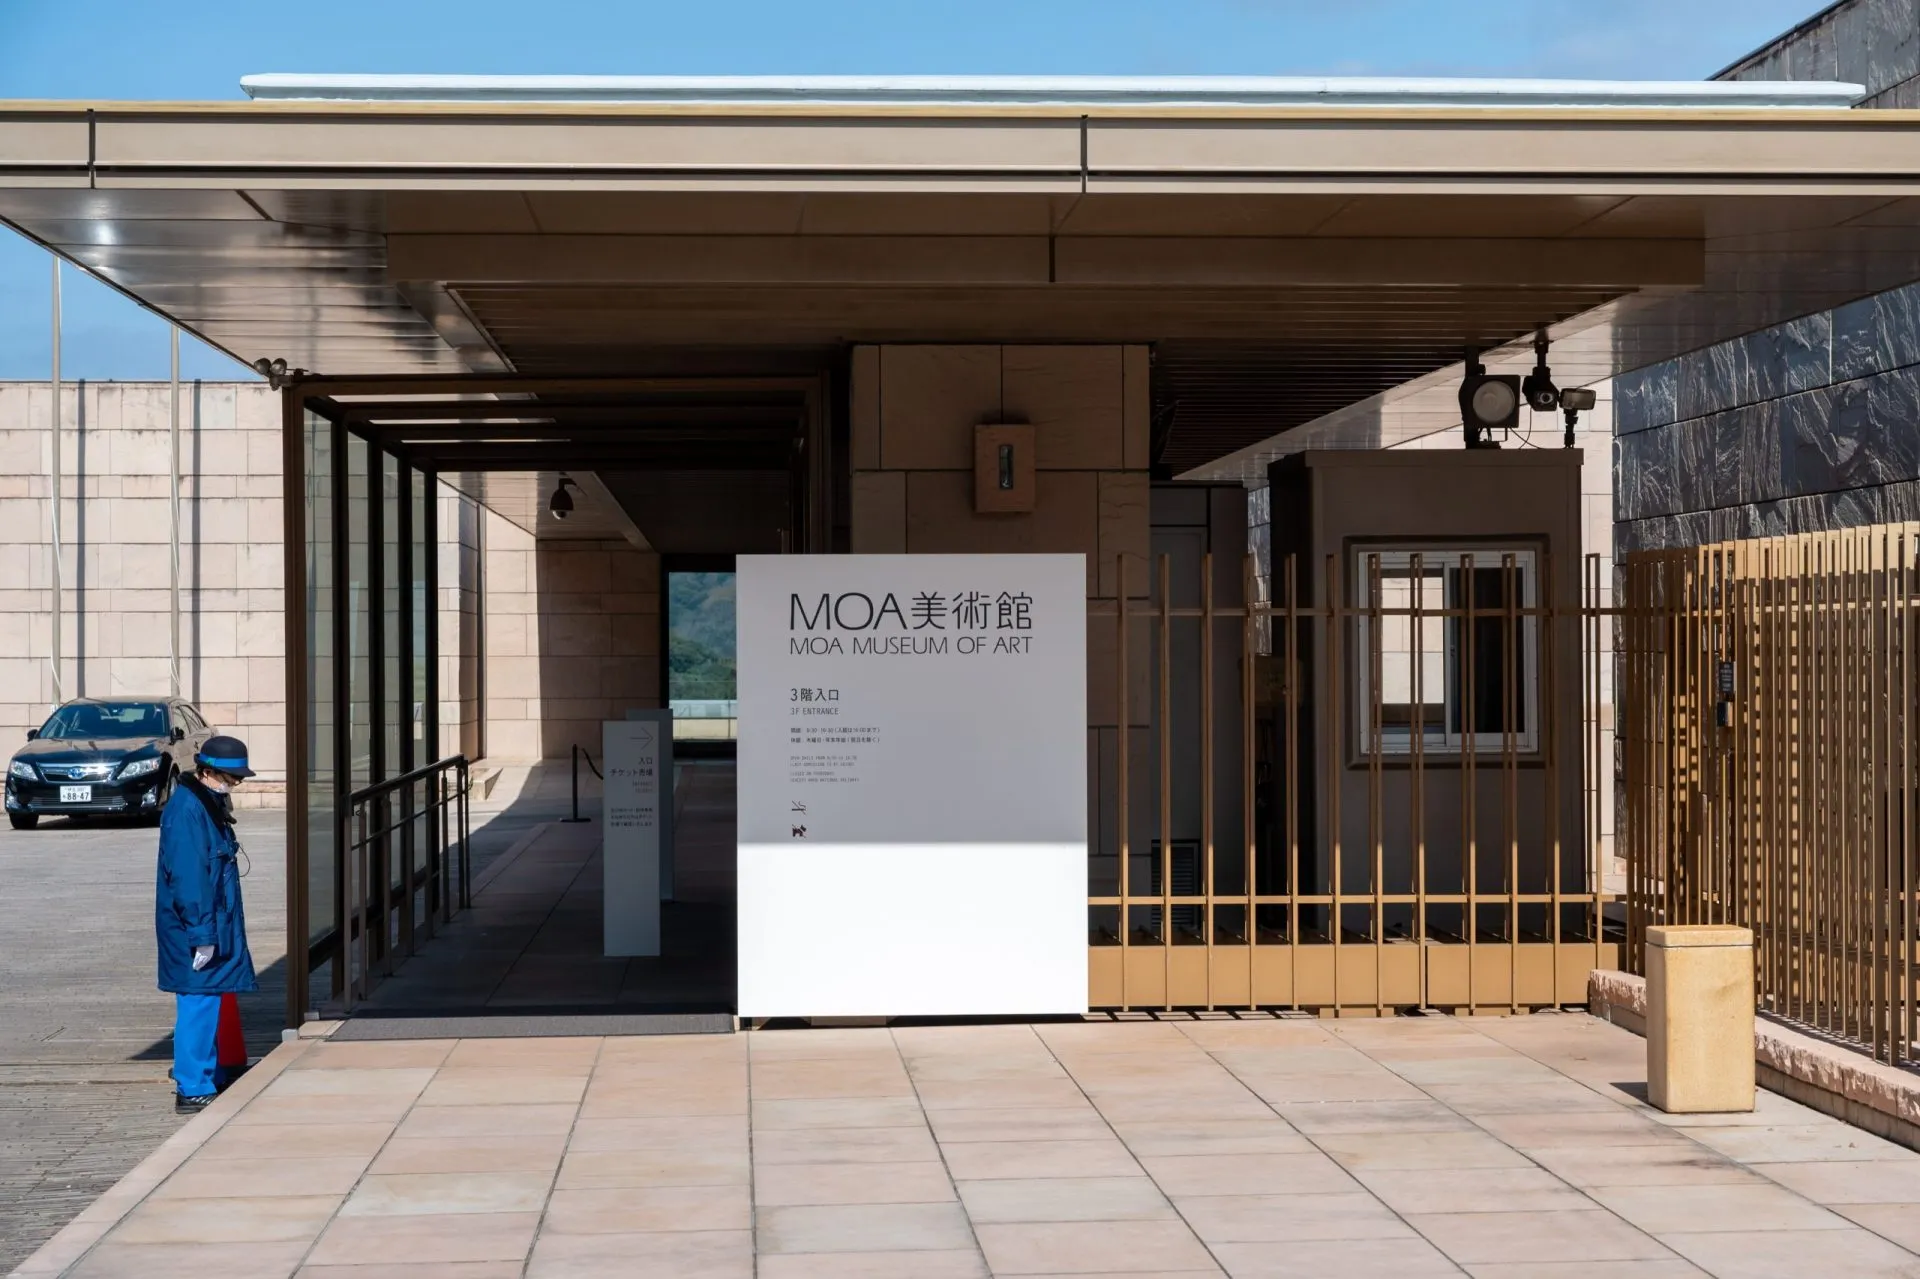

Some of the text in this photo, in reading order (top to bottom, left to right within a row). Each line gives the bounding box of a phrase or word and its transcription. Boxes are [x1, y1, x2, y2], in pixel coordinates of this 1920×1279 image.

[790, 591, 1033, 630] MOA美術館
[790, 636, 1033, 655] MOA MUSEUM OF ART
[790, 688, 839, 701] 3階入口
[790, 707, 839, 715] 3F ENTRANCE
[638, 756, 653, 765] 入口
[67, 792, 89, 800] 88-47
